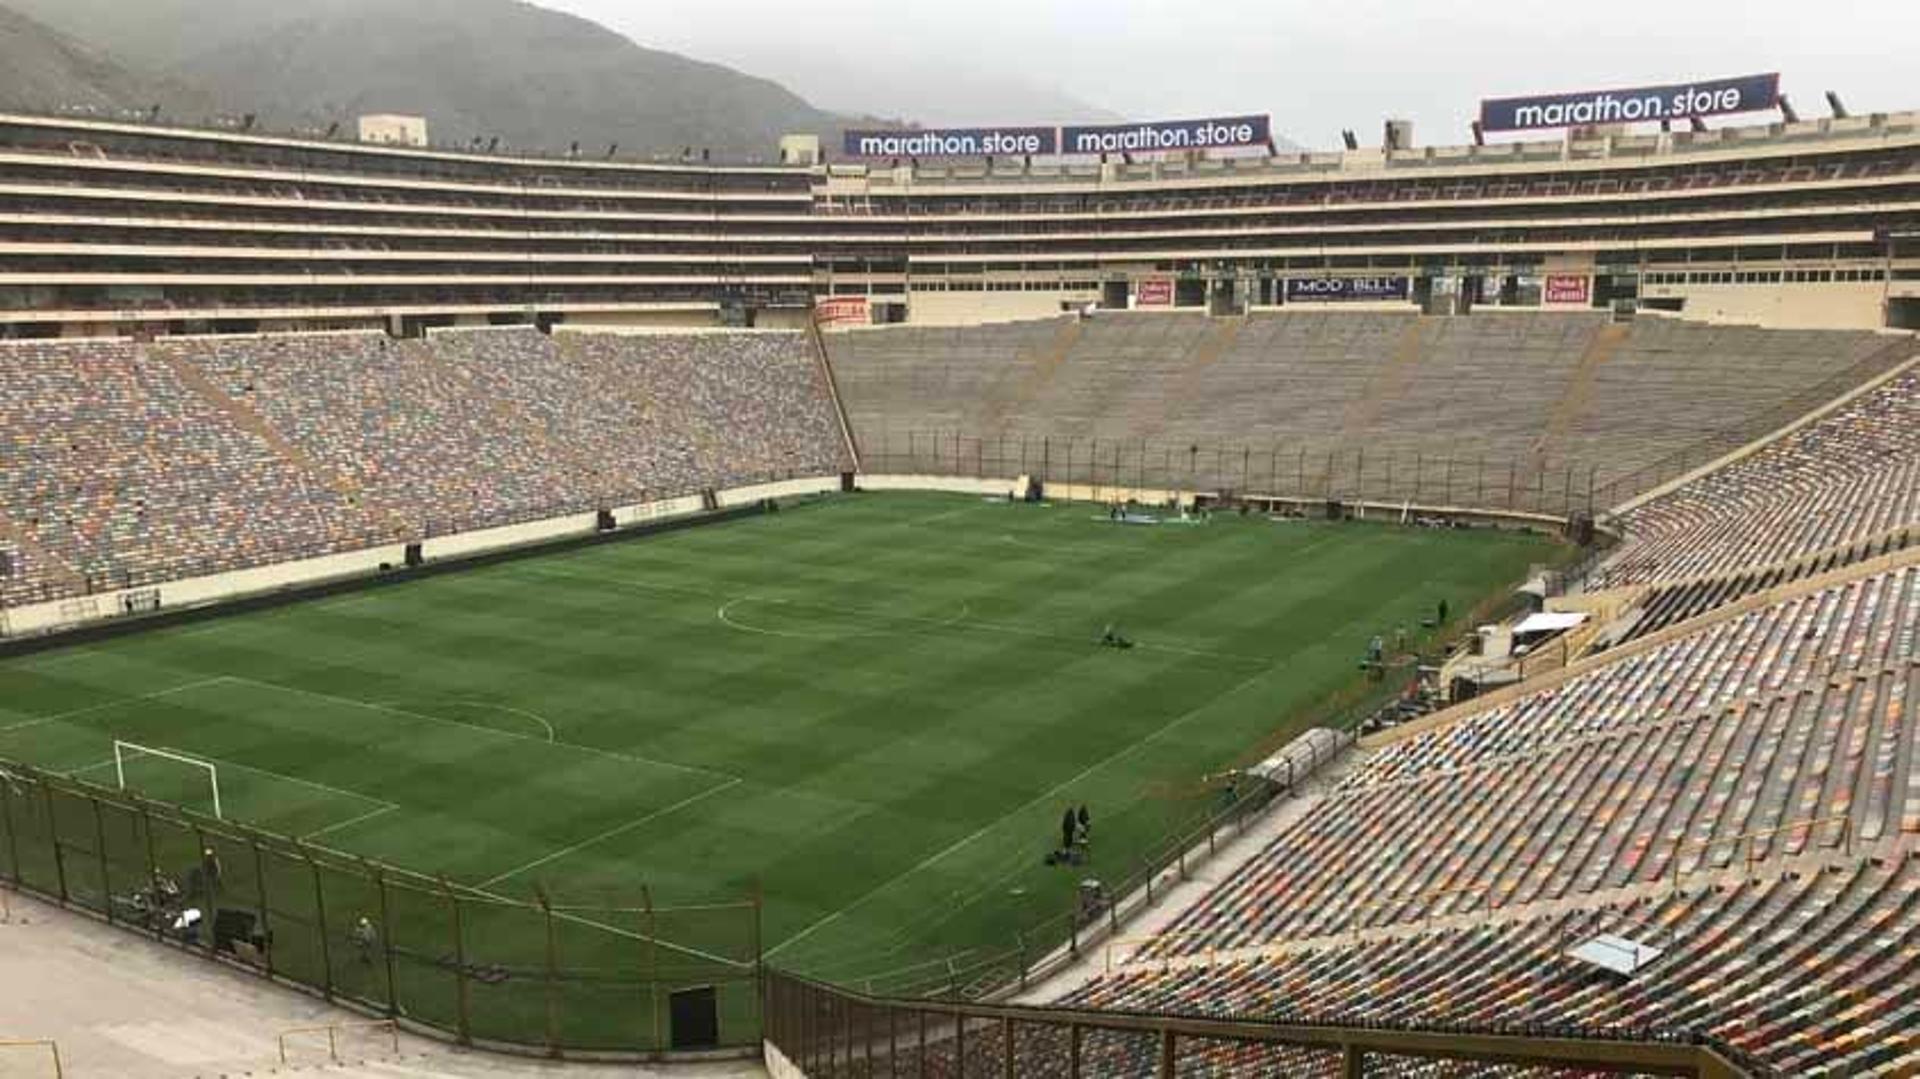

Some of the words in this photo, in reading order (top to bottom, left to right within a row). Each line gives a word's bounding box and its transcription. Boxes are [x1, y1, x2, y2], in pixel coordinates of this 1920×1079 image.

[1515, 87, 1741, 126] marathon.store
[860, 131, 1040, 155] marathon.store
[1077, 122, 1253, 151] marathon.store
